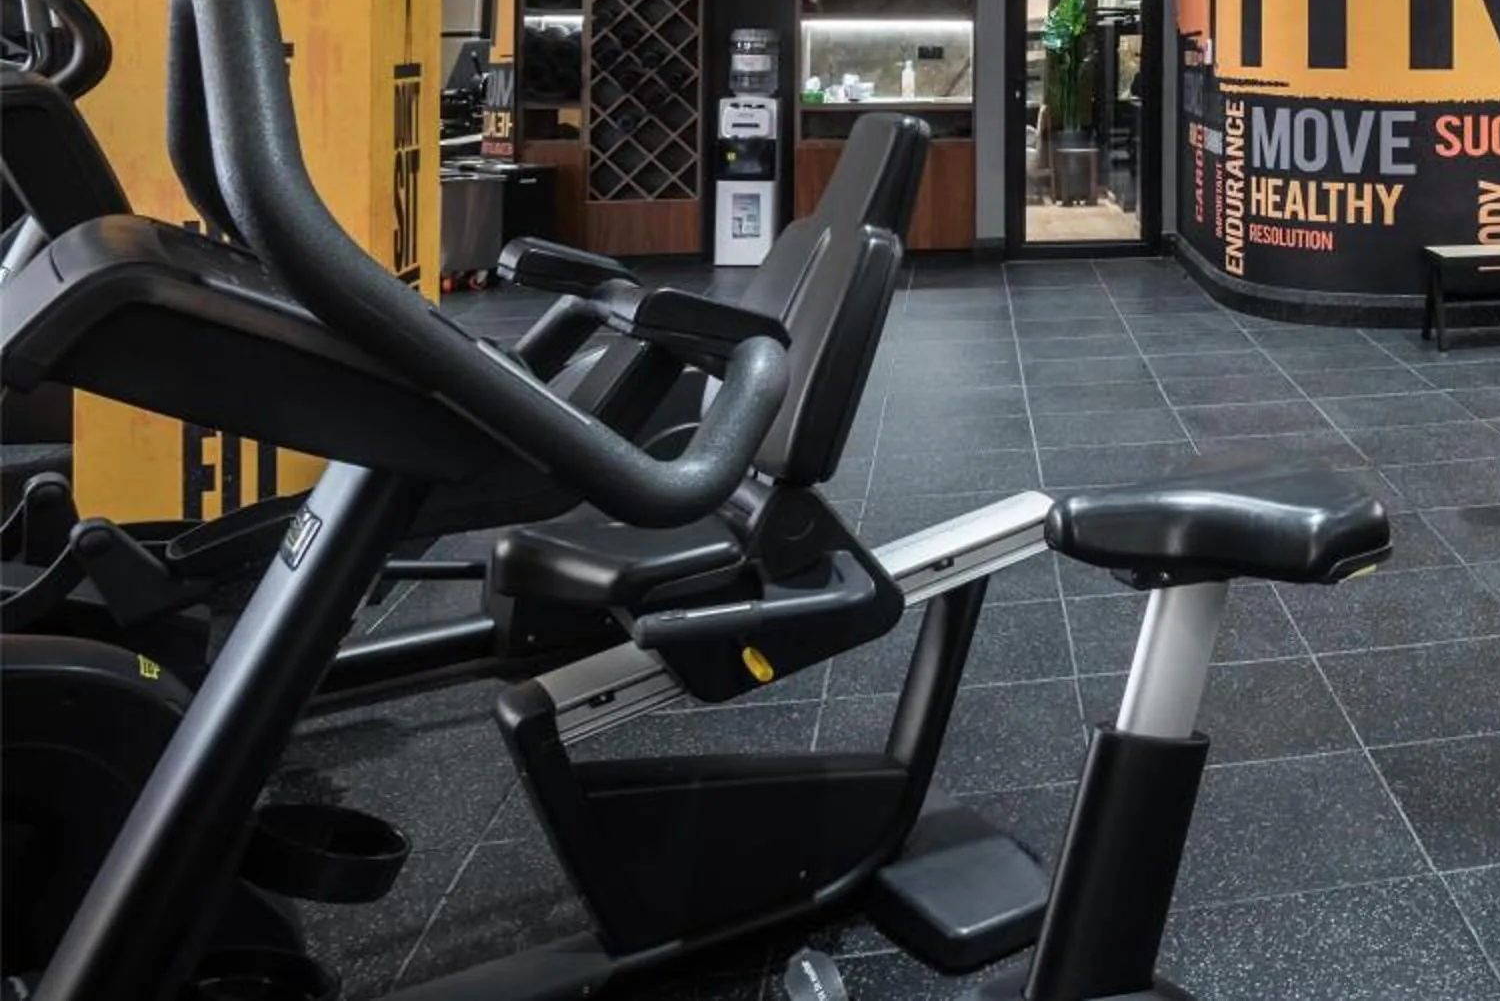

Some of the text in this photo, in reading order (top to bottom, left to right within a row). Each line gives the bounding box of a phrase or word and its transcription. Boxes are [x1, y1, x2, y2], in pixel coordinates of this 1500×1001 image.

[1252, 106, 1417, 175] MOVE
[393, 149, 420, 273] SIT
[1225, 99, 1245, 276] ENDURANCE
[1251, 175, 1404, 226] HEALTHY
[1250, 224, 1333, 251] RESOLUTION
